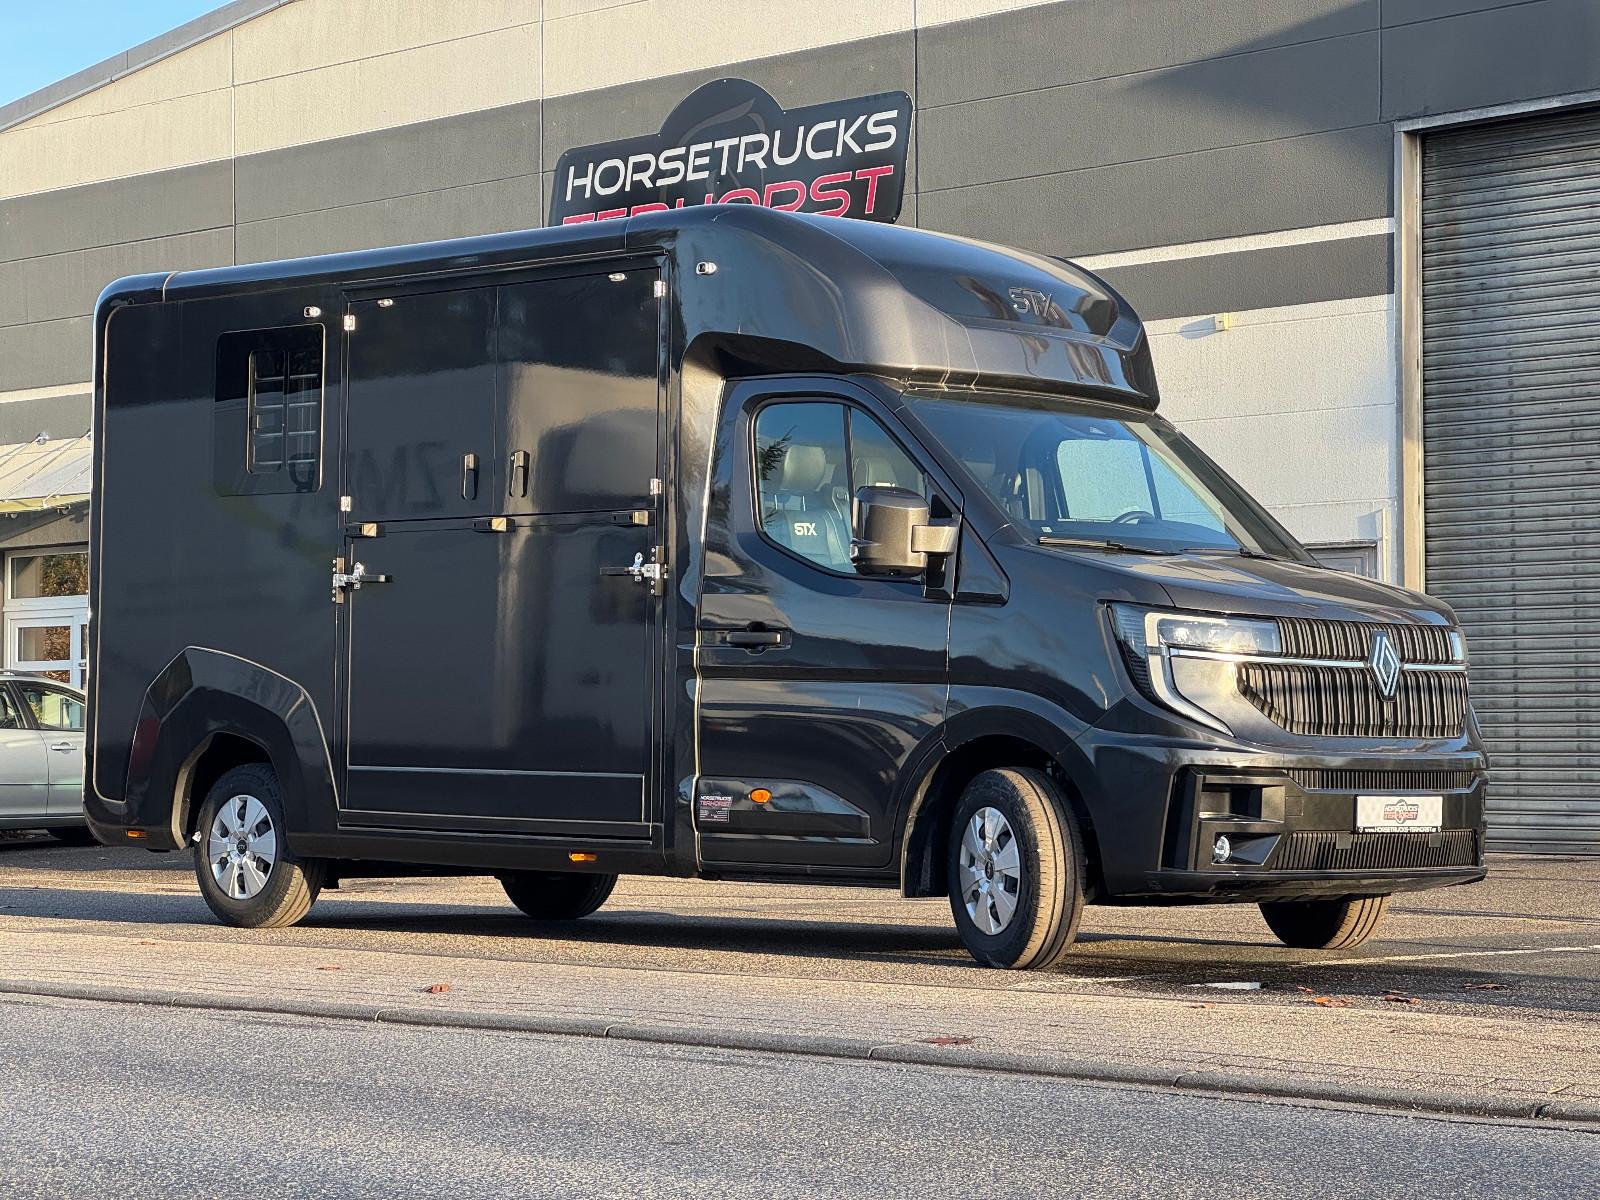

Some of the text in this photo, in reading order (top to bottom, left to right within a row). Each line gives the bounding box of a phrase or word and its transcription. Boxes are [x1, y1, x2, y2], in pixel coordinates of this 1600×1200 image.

[565, 109, 899, 201] HORSETRUCKS
[1008, 286, 1059, 320] STX
[794, 522, 817, 536] STX
